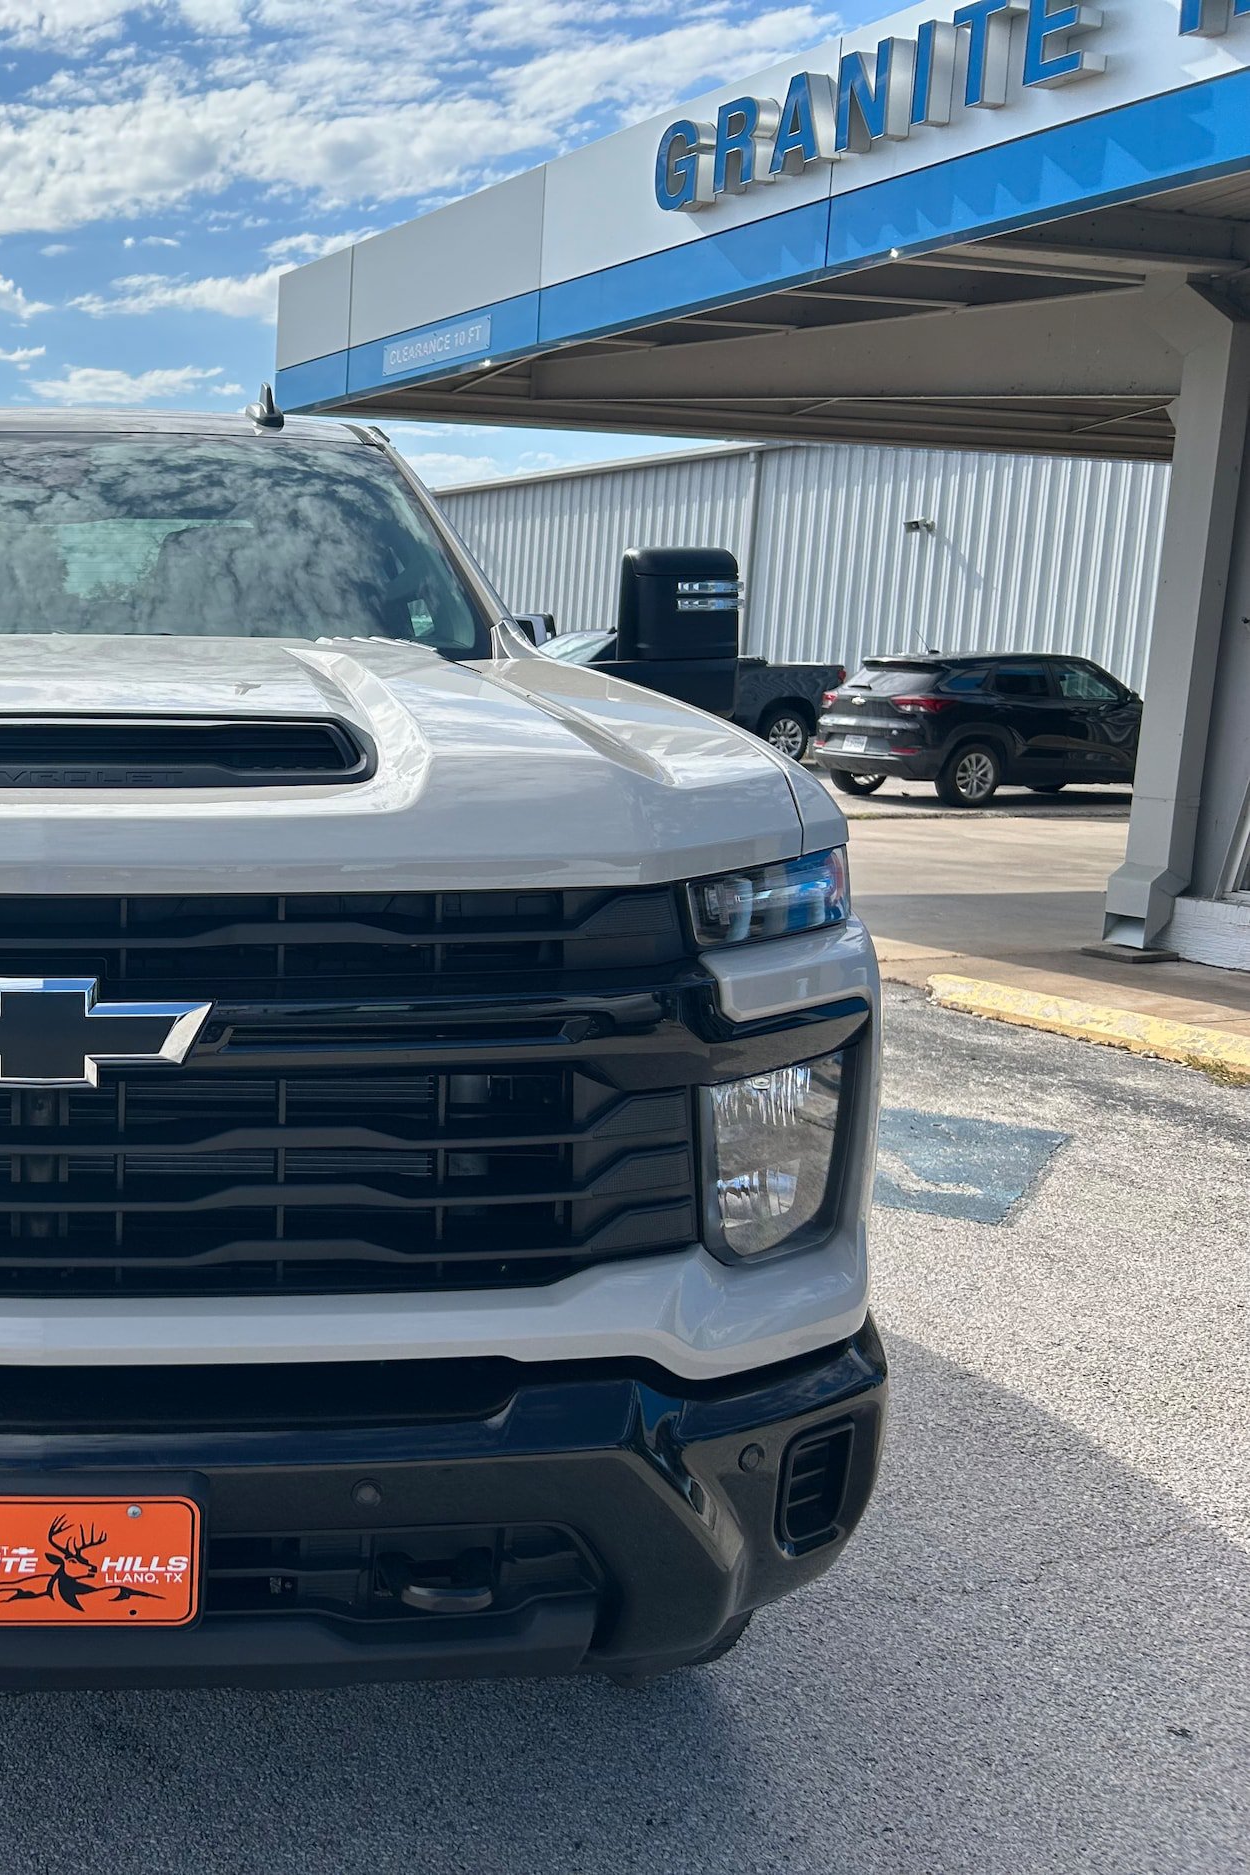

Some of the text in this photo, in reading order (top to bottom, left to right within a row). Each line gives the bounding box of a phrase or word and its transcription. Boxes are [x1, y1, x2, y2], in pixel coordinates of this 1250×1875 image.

[389, 325, 482, 366] CLEARANCE 10 FT
[101, 1556, 189, 1572] HILLS
[105, 1572, 183, 1585] LLANO, TX
